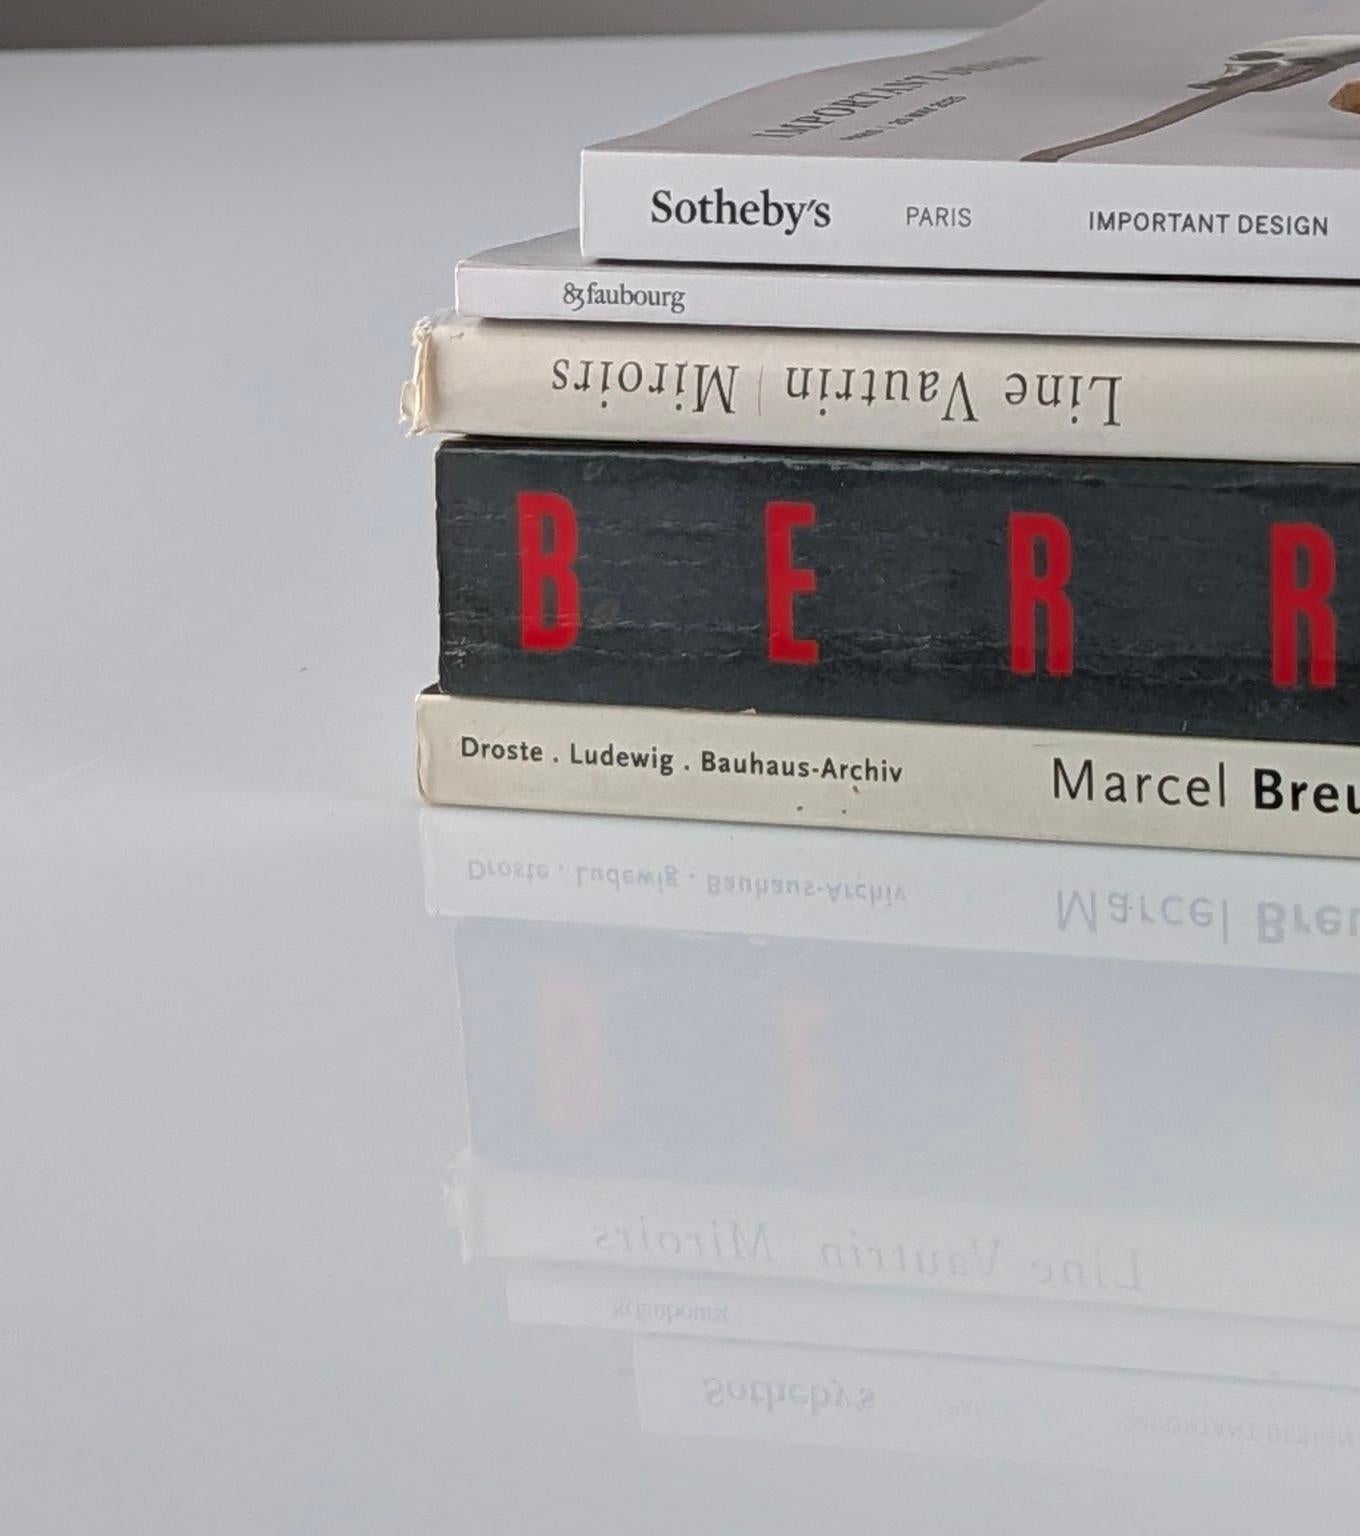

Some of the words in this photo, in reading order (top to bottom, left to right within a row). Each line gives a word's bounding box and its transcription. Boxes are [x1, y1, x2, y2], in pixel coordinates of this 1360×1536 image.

[751, 74, 948, 139] IMPORTANT
[650, 186, 832, 234] Sotheby's
[906, 206, 973, 229] PARIS
[1088, 210, 1232, 235] IMPORTANT
[1237, 213, 1329, 237] DESIGN
[551, 358, 740, 415] Miroirs
[785, 366, 980, 423] Vautrin
[1004, 372, 1123, 428] Line
[460, 735, 544, 763] Droste
[569, 742, 675, 777] Ludewig
[700, 749, 904, 784] Bauhaus-Archiv
[1052, 756, 1226, 809] Marcel
